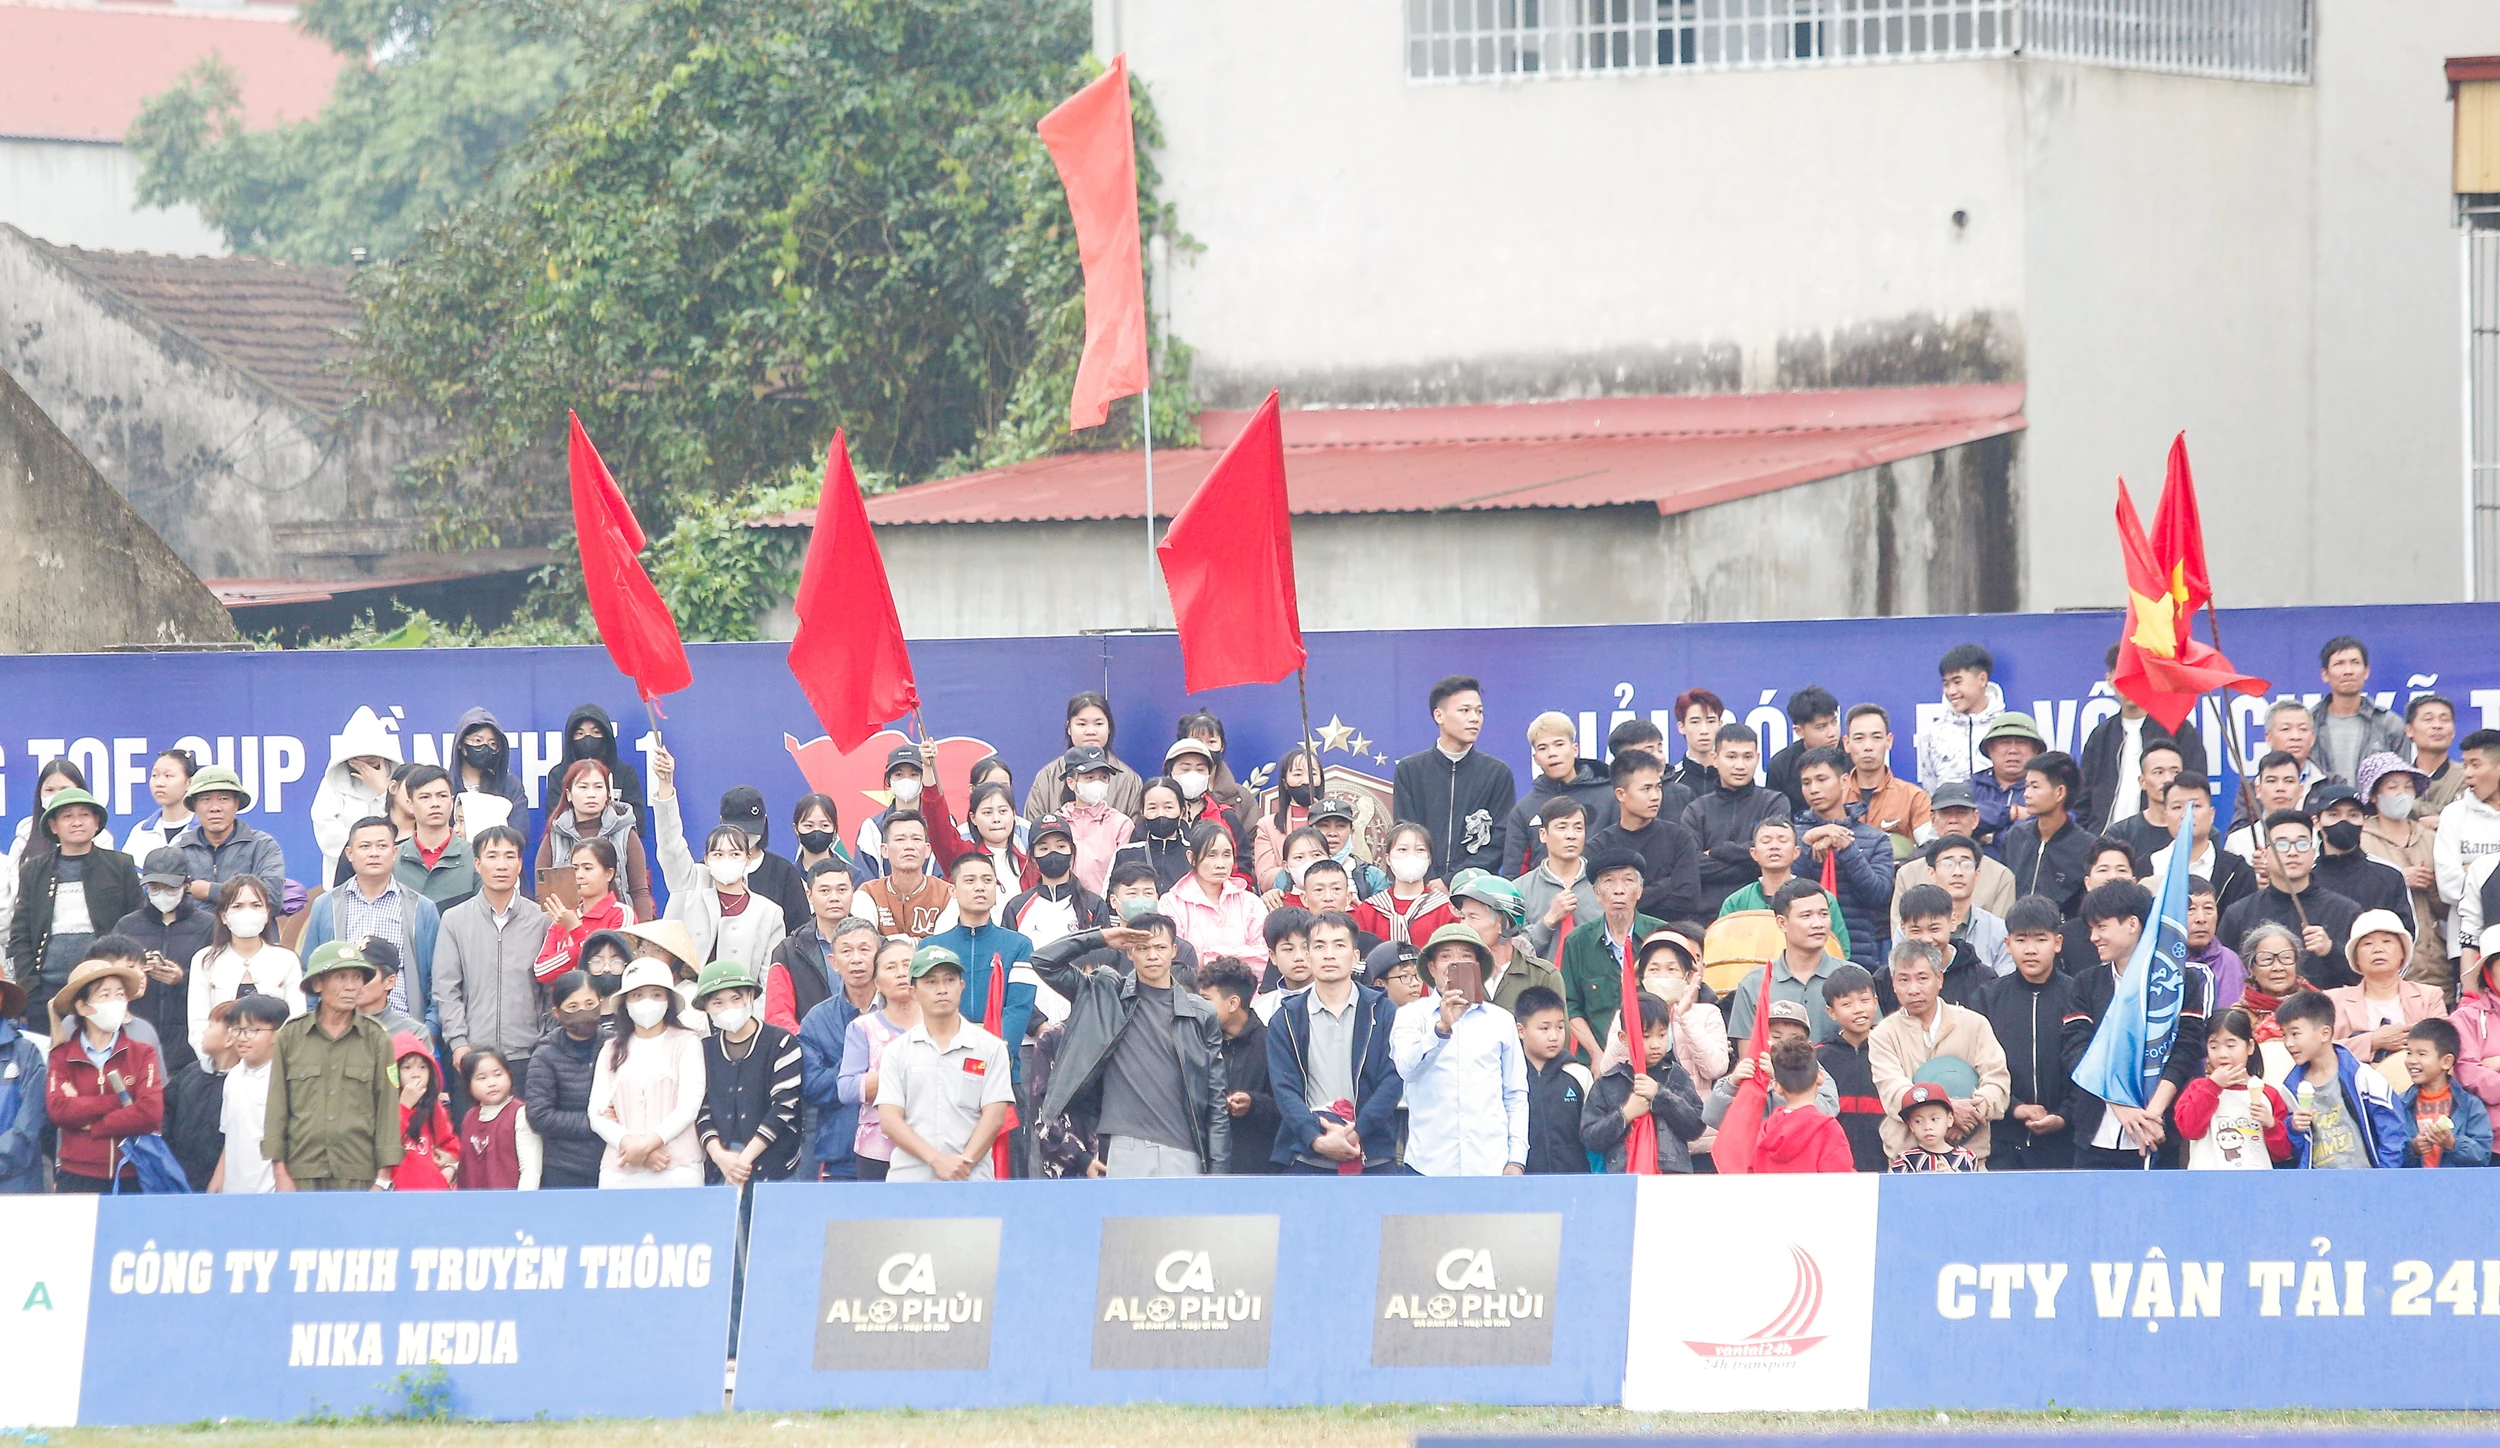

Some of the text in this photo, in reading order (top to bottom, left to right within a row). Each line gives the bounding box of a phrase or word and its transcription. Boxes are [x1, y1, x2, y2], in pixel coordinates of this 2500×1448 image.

[1531, 682, 1669, 781] IẢI
[172, 735, 307, 815] UP
[109, 1229, 713, 1295] CÔNG TY TNHH TRUYỀN THÔNG
[877, 1252, 937, 1296] CA
[1155, 1249, 1215, 1293] CA
[1435, 1247, 1497, 1291] CA
[22, 1281, 54, 1311] A
[902, 1291, 984, 1323] PHỦI
[1180, 1288, 1261, 1321] PHỦI
[1462, 1286, 1544, 1319] PHỦI
[1936, 1262, 2069, 1320] CTY
[2090, 1245, 2225, 1334] VẬN
[2249, 1236, 2367, 1317] TẢI
[289, 1320, 518, 1366] NIKA MEDIA
[1703, 1359, 1797, 1371] 24h transport
